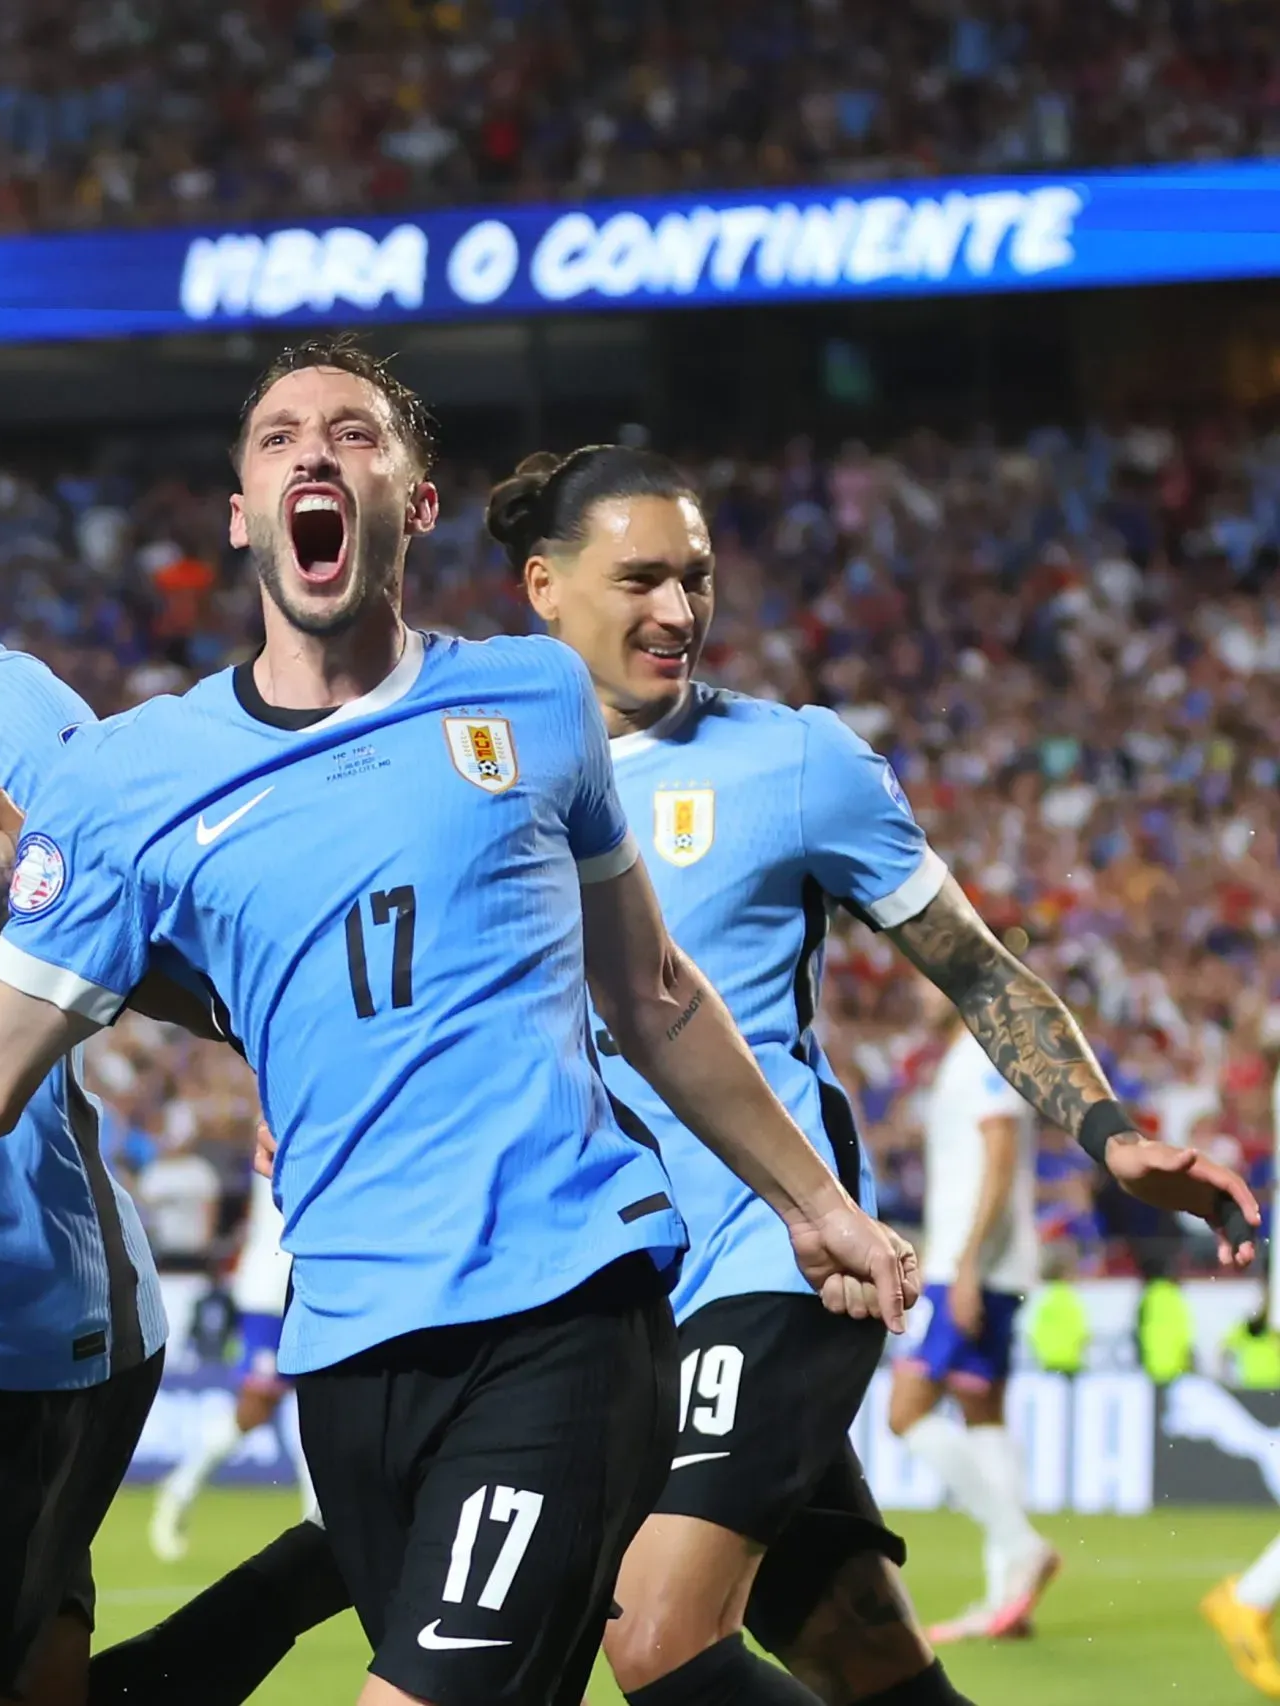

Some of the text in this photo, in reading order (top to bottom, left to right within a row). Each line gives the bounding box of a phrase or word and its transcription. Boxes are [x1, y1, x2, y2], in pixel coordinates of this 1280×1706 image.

[447, 220, 519, 303] O
[530, 187, 1082, 300] CONTINENTE
[345, 885, 416, 1019] 17
[678, 1345, 744, 1436] 19
[442, 1485, 544, 1611] 17
